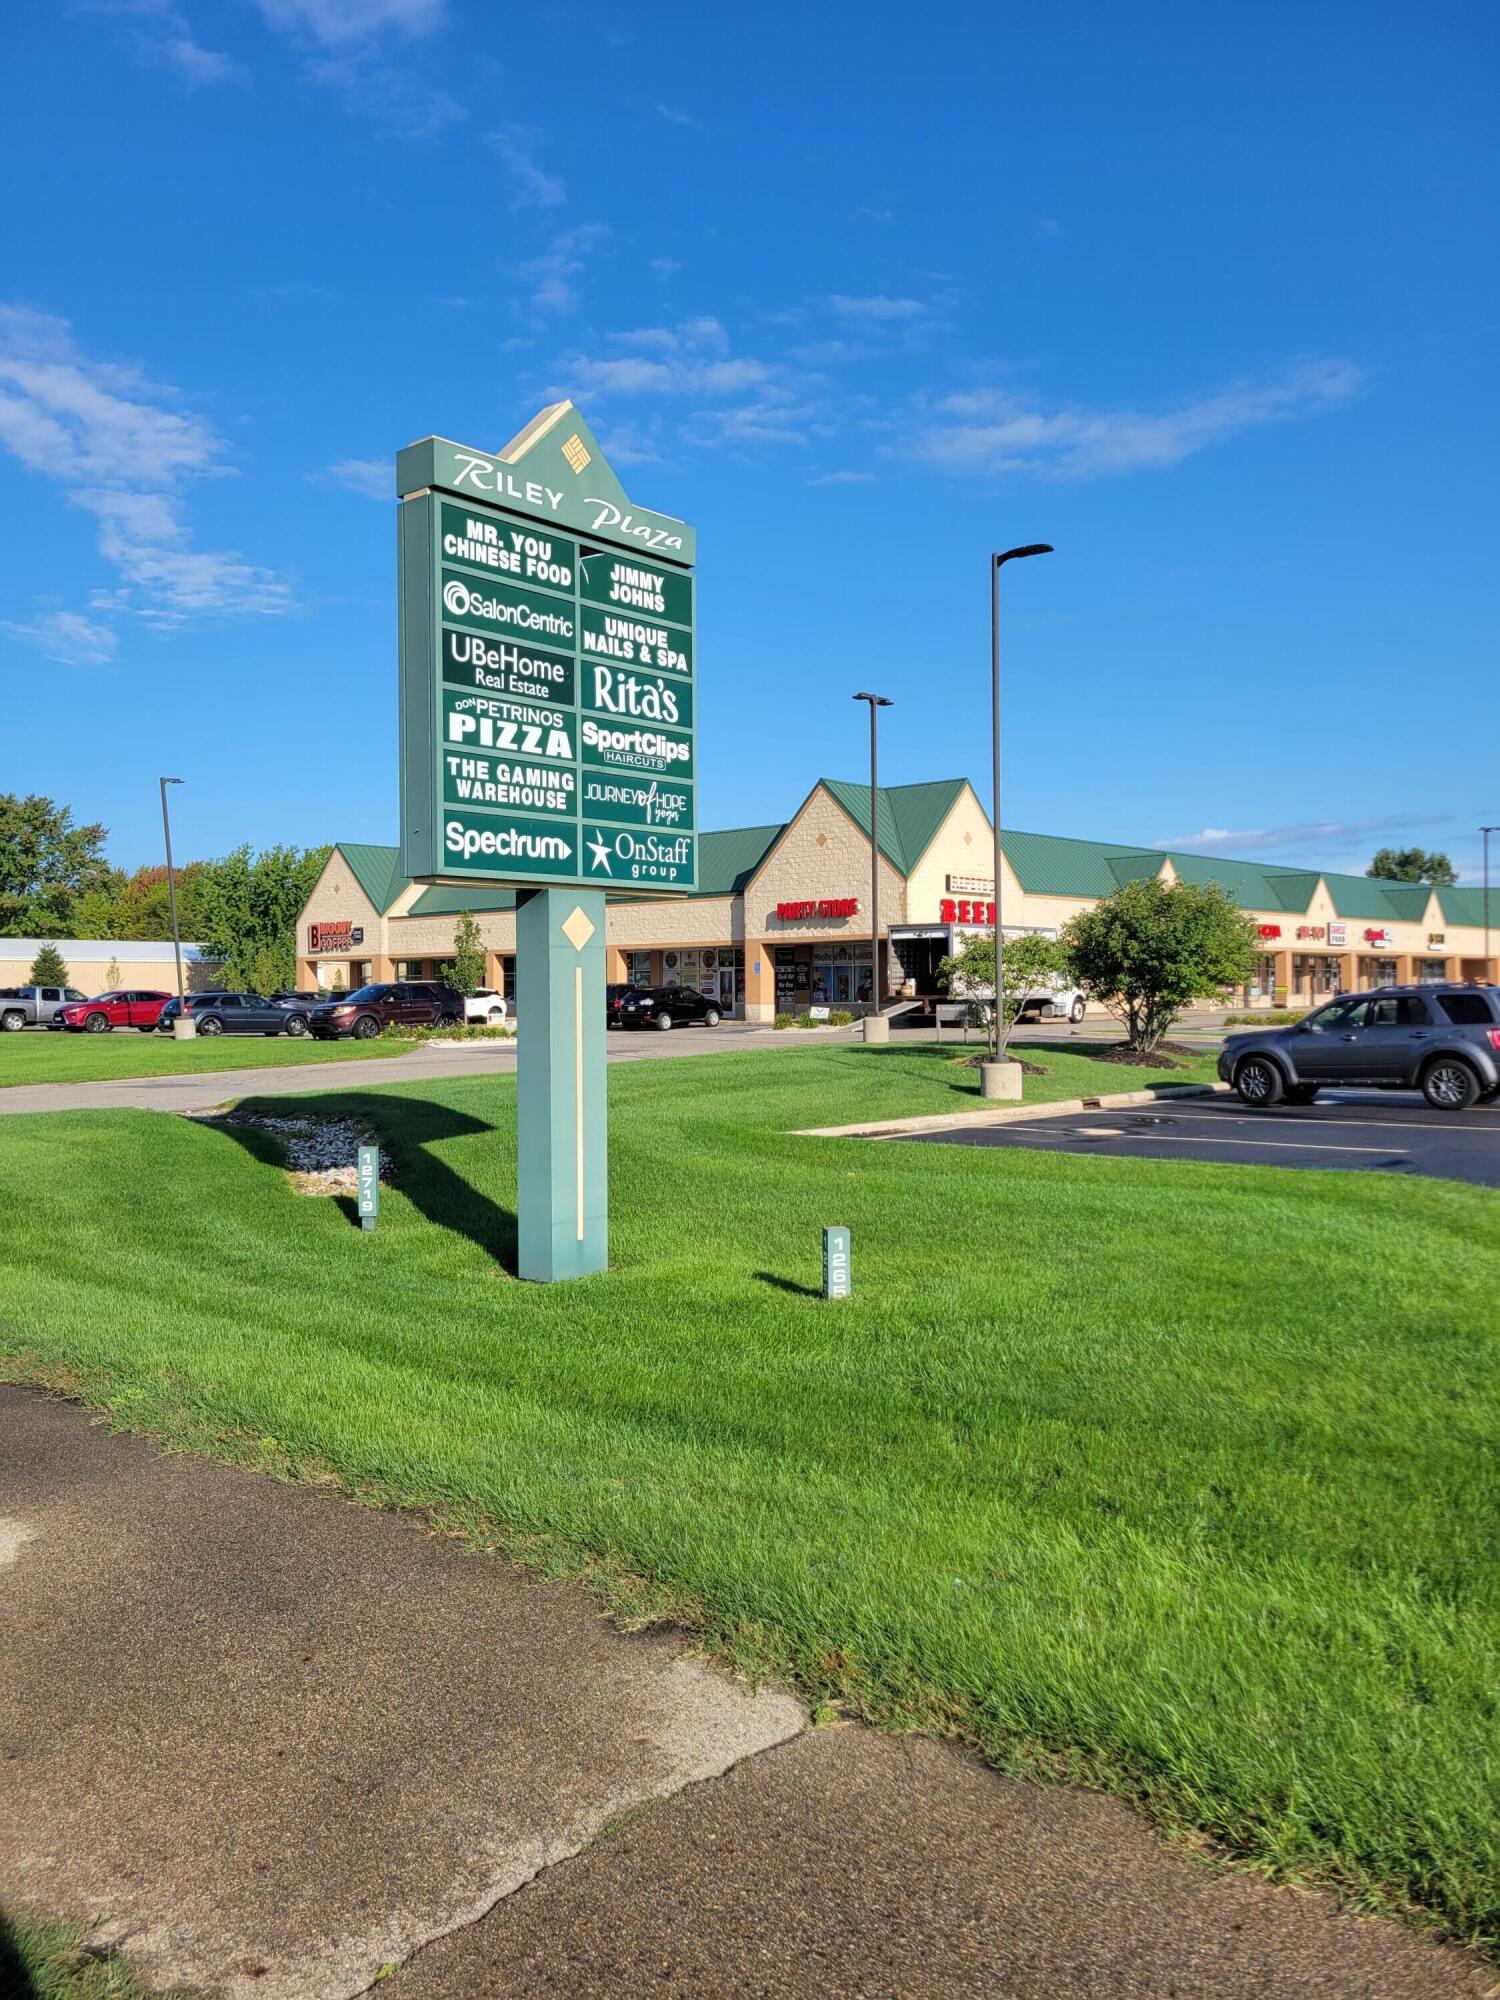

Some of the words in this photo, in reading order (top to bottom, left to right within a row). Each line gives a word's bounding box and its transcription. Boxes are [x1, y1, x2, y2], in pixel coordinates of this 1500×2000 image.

[465, 518, 504, 548] MR.
[510, 531, 552, 561] YOU
[443, 533, 521, 573] CHINESE
[526, 557, 572, 587] FOOD
[610, 563, 664, 593] JIMMY
[609, 582, 665, 613] JOHNS
[469, 594, 573, 638] SalonCentric
[605, 616, 668, 650] UNIQUE
[451, 633, 565, 684] UBeHome
[583, 630, 634, 659] NAILS
[640, 645, 652, 664] &
[657, 649, 689, 673] SPA
[475, 668, 505, 690] Real
[509, 675, 549, 698] Estate
[593, 666, 679, 723] Rita's
[455, 698, 476, 711] DON
[476, 698, 564, 728] PETRINOS
[449, 712, 573, 759] PIZZA
[582, 721, 690, 763] SportClips
[447, 756, 489, 780] THE
[496, 763, 574, 791] GAMING
[606, 752, 664, 769] HAIRCUTS
[456, 778, 567, 810] WAREHOUSE
[584, 783, 641, 804] JOURNEY
[638, 781, 657, 824] of
[656, 792, 687, 811] HOPE
[655, 808, 679, 825] yoga
[446, 821, 564, 860] Spectrum
[615, 833, 691, 864] OnStaff
[632, 864, 677, 880] group
[777, 901, 817, 919] PARTY
[818, 898, 858, 918] STORE
[362, 1153, 373, 1211] 12719
